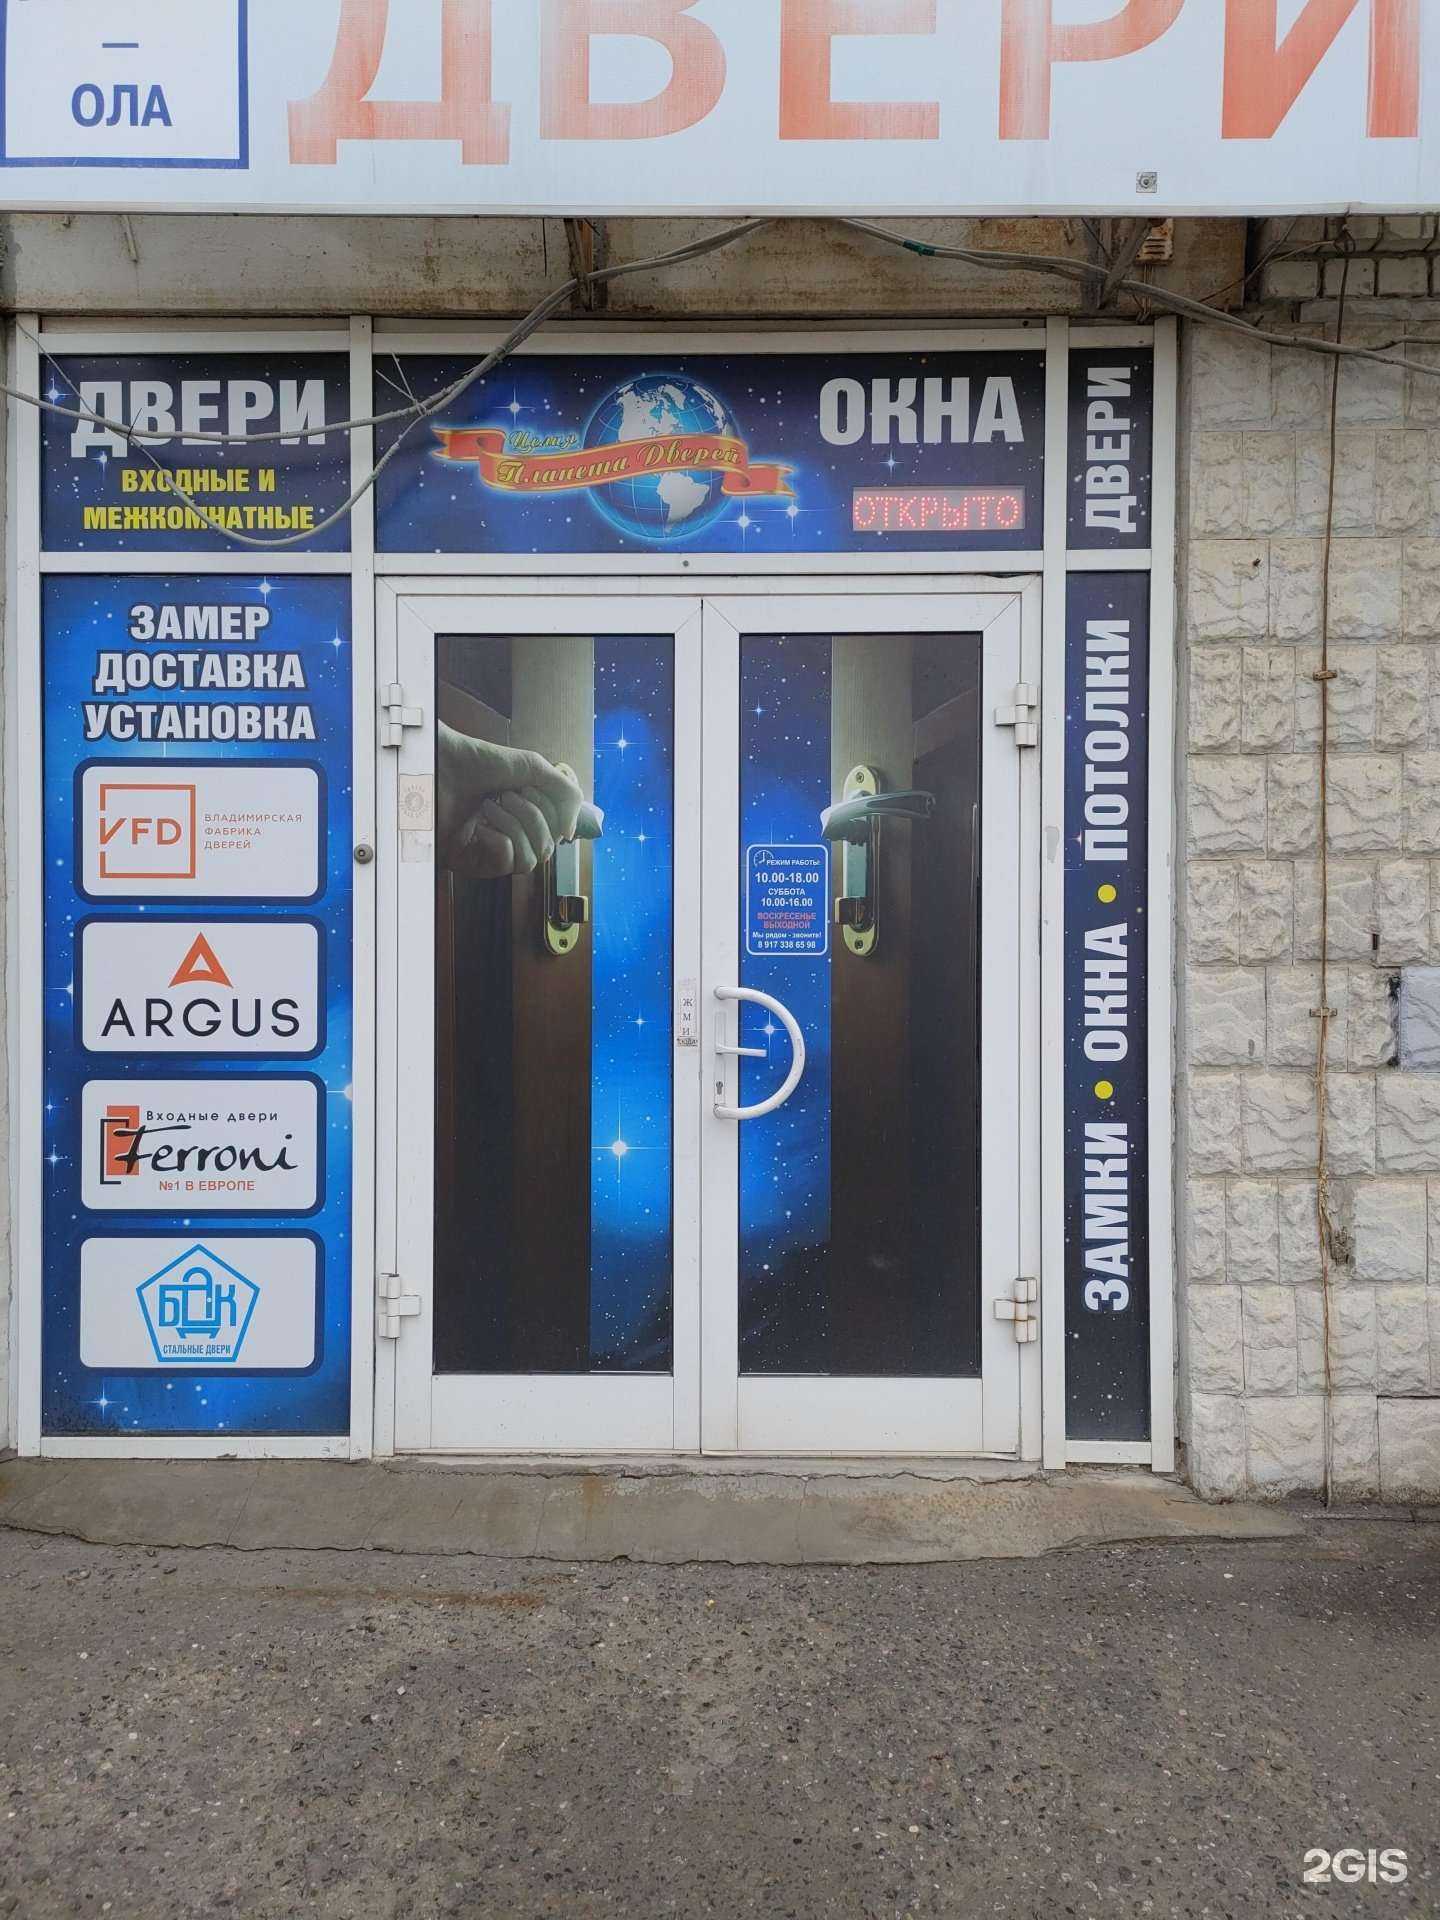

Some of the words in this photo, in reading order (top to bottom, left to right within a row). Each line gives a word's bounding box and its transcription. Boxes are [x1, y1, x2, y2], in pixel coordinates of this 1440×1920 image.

[288, 0, 1419, 165] ДВЕРИ
[71, 83, 173, 128] ОЛА
[71, 379, 326, 458] ДВЕРИ
[819, 376, 1025, 446] ОКНА
[496, 455, 630, 484] Планета
[636, 438, 743, 467] Дверей
[1085, 367, 1137, 533] ДВЕРИ
[121, 469, 250, 495] ВХОДНЫЕ
[258, 469, 276, 493] И
[83, 506, 315, 531] МЕЖКОМНАТНЫЕ
[854, 495, 1020, 528] ОТКРЫТО
[130, 604, 270, 641] ЗАМЕР
[95, 652, 306, 694] ДОСТАВКА
[85, 703, 317, 741] УСТАНОВКА
[1084, 619, 1130, 862] ПОТОЛКИ
[99, 817, 182, 846] VFD
[204, 813, 303, 823] ВЛАДИМИРСКАЯ
[204, 826, 262, 836] ФАБРИКА
[204, 839, 251, 850] ДВЕРЕЙ
[766, 859, 791, 867] РЕЖИМ
[755, 872, 819, 883] 10.00-18.00
[761, 897, 813, 907] 10.00-16.00
[768, 888, 806, 896] СУББОТА
[757, 911, 817, 920] ВОСКРЕСЕНЬЕ
[763, 920, 811, 929] ВЫХОДНОЙ
[764, 941, 778, 949] 917
[765, 932, 787, 940] рядом
[1084, 921, 1129, 1062] ОКНА
[101, 998, 300, 1037] ARGUS
[146, 1110, 219, 1123] Входные
[227, 1112, 279, 1123] двери
[113, 1124, 298, 1174] Ferroni
[159, 1180, 180, 1191] №1
[185, 1180, 194, 1191] В
[199, 1180, 256, 1191] ЕВРОПЕ
[1084, 1121, 1129, 1311] ЗАМКИ
[163, 1345, 204, 1355] СТАЛЬНЫЕ
[205, 1345, 231, 1356] ДВЕРИ
